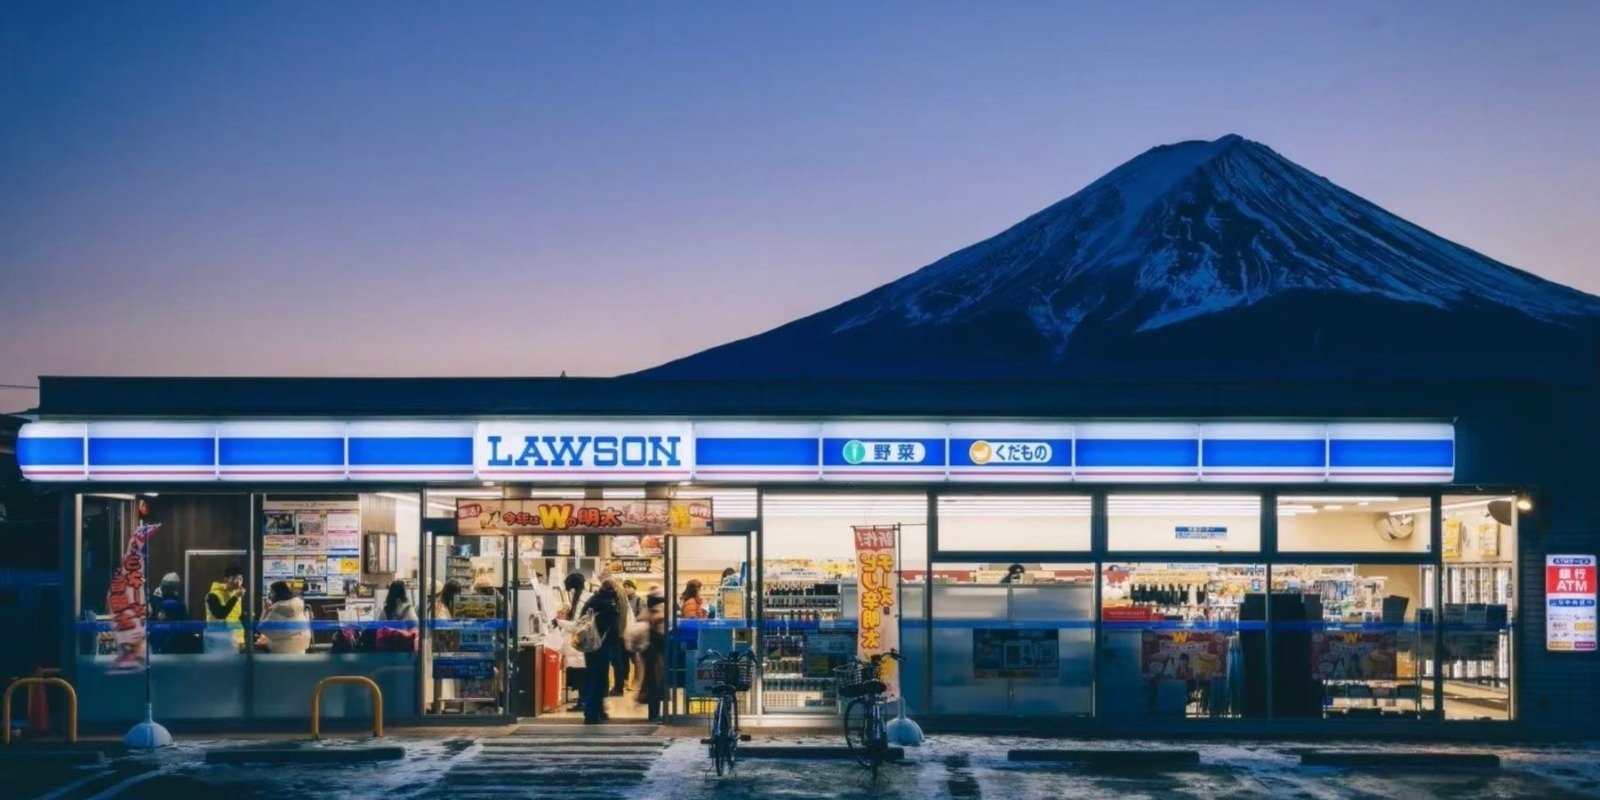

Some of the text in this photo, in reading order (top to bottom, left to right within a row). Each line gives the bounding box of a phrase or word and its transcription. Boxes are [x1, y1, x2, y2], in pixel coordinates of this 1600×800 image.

[487, 436, 681, 466] LAWSON
[874, 444, 915, 461] 野菜
[996, 444, 1047, 461] くだもの
[1558, 568, 1587, 580] 銀行
[1556, 580, 1588, 592] ATM
